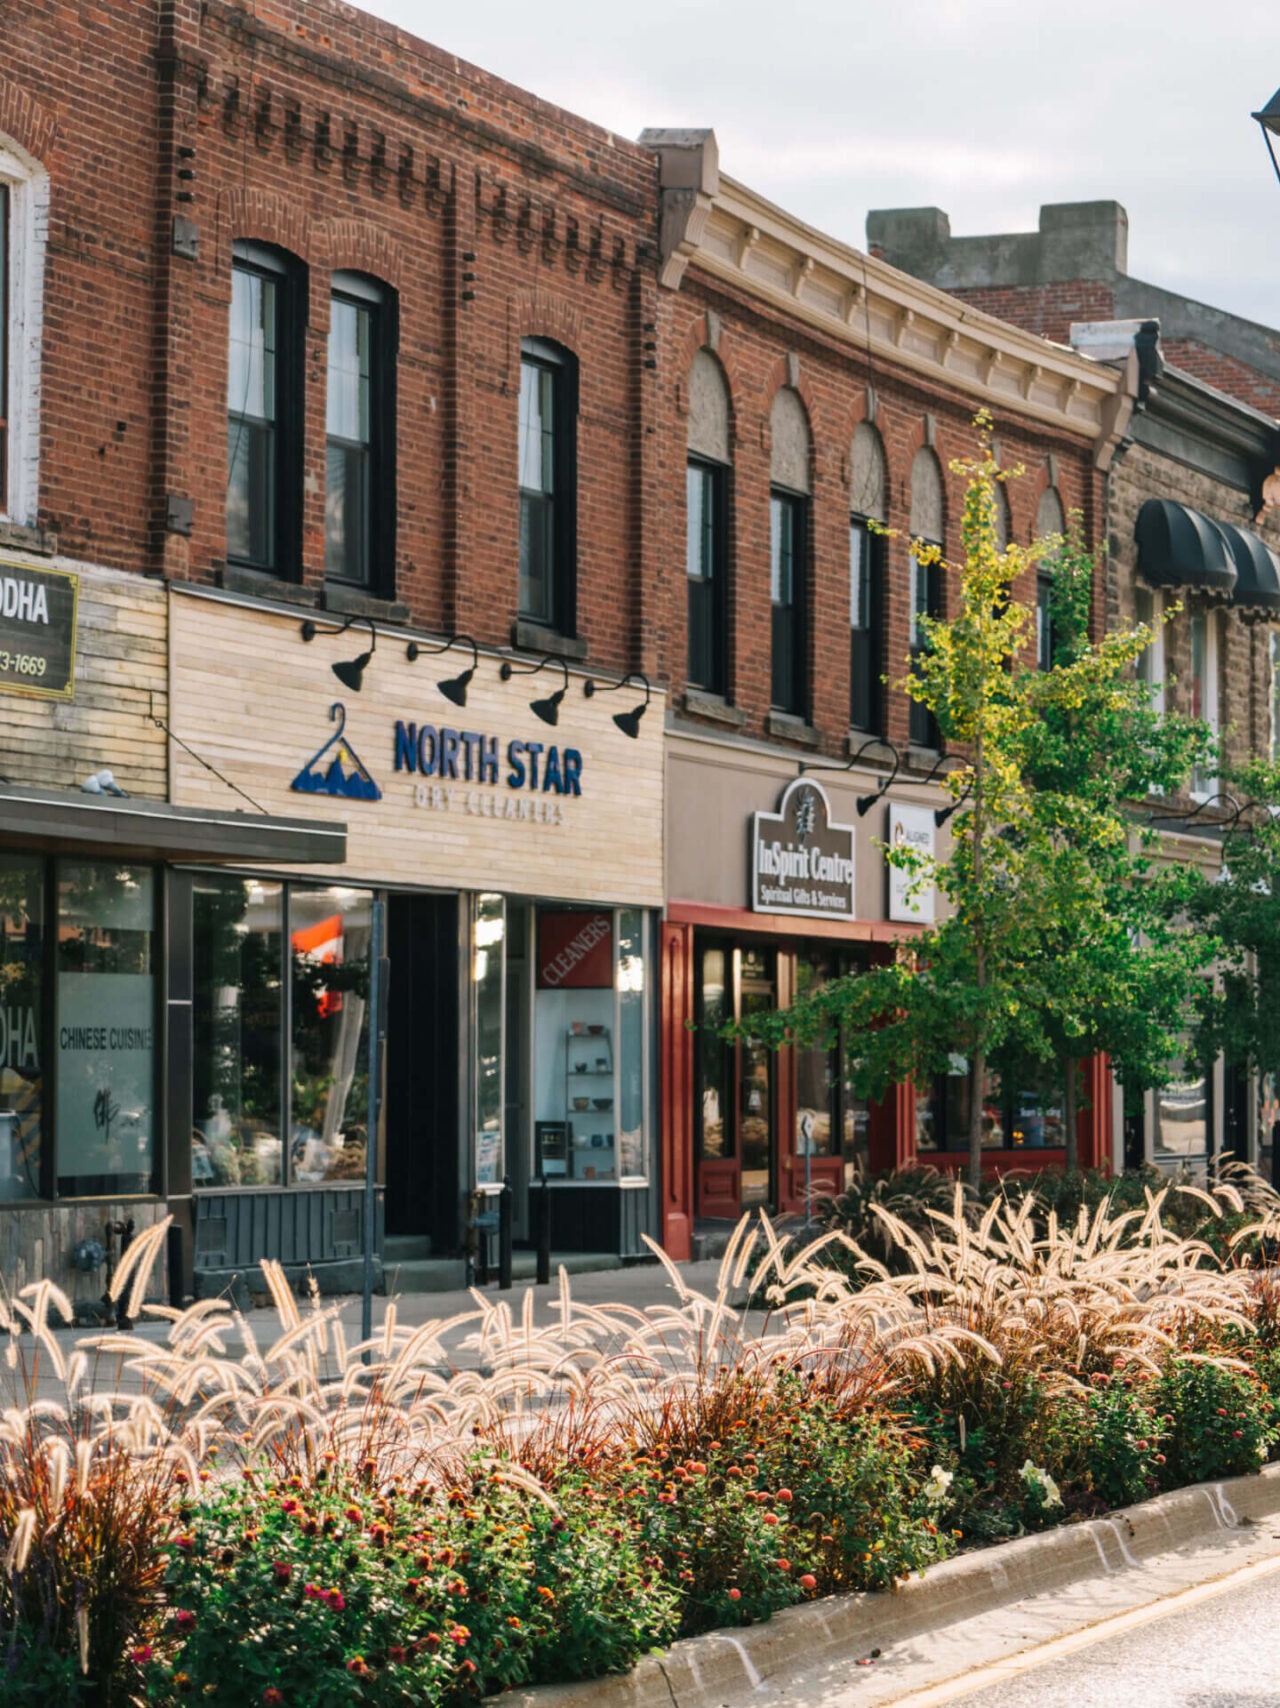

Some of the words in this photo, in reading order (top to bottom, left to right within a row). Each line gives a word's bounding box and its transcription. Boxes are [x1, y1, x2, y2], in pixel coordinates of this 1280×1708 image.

[0, 577, 49, 625] DHA
[0, 651, 46, 677] 3-1669
[394, 720, 500, 785] NORTH
[507, 739, 583, 797] STAR
[416, 784, 454, 810] DRY
[758, 839, 809, 886] InSpirit
[810, 846, 854, 884] Centre
[761, 884, 792, 905] Spiritual
[793, 889, 810, 906] Gifts
[811, 892, 817, 906] &
[818, 892, 846, 909] Services
[541, 914, 611, 986] CLEANERS
[60, 1027, 107, 1050] CHINESE
[109, 1027, 153, 1050] CUISINE
